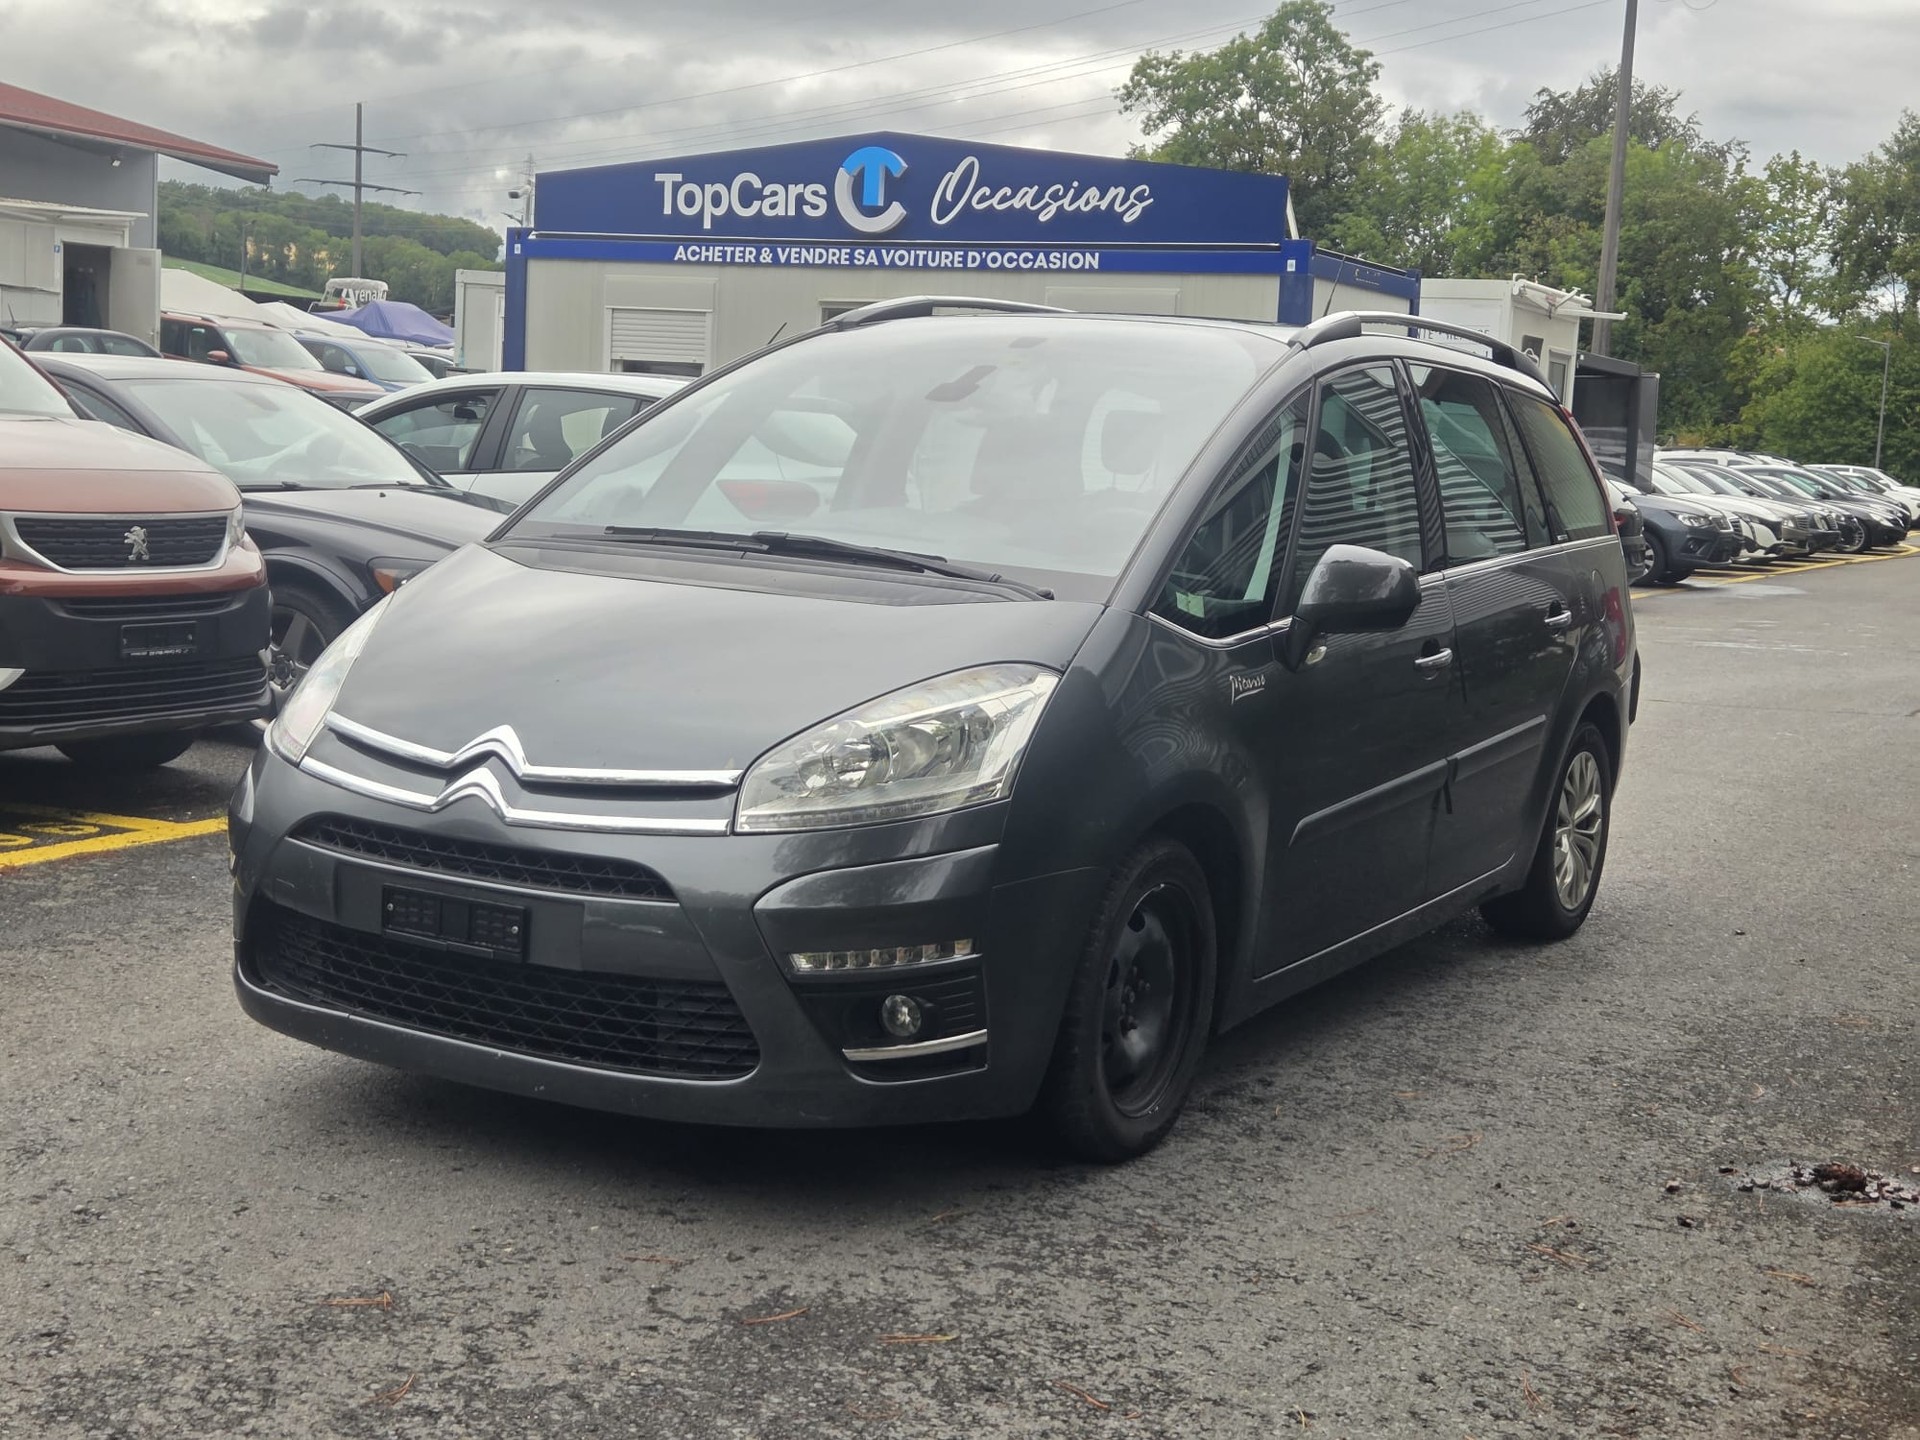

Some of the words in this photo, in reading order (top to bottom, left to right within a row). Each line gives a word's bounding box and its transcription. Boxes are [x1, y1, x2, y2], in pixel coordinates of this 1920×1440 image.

[654, 172, 828, 230] TopCars
[930, 156, 1154, 224] Occasions
[674, 245, 757, 263] ACHETER
[759, 248, 773, 264] &
[777, 247, 850, 265] VENDRE
[853, 249, 879, 266] SA
[881, 249, 964, 268] VOITURE
[967, 251, 1100, 270] D'OCCASION
